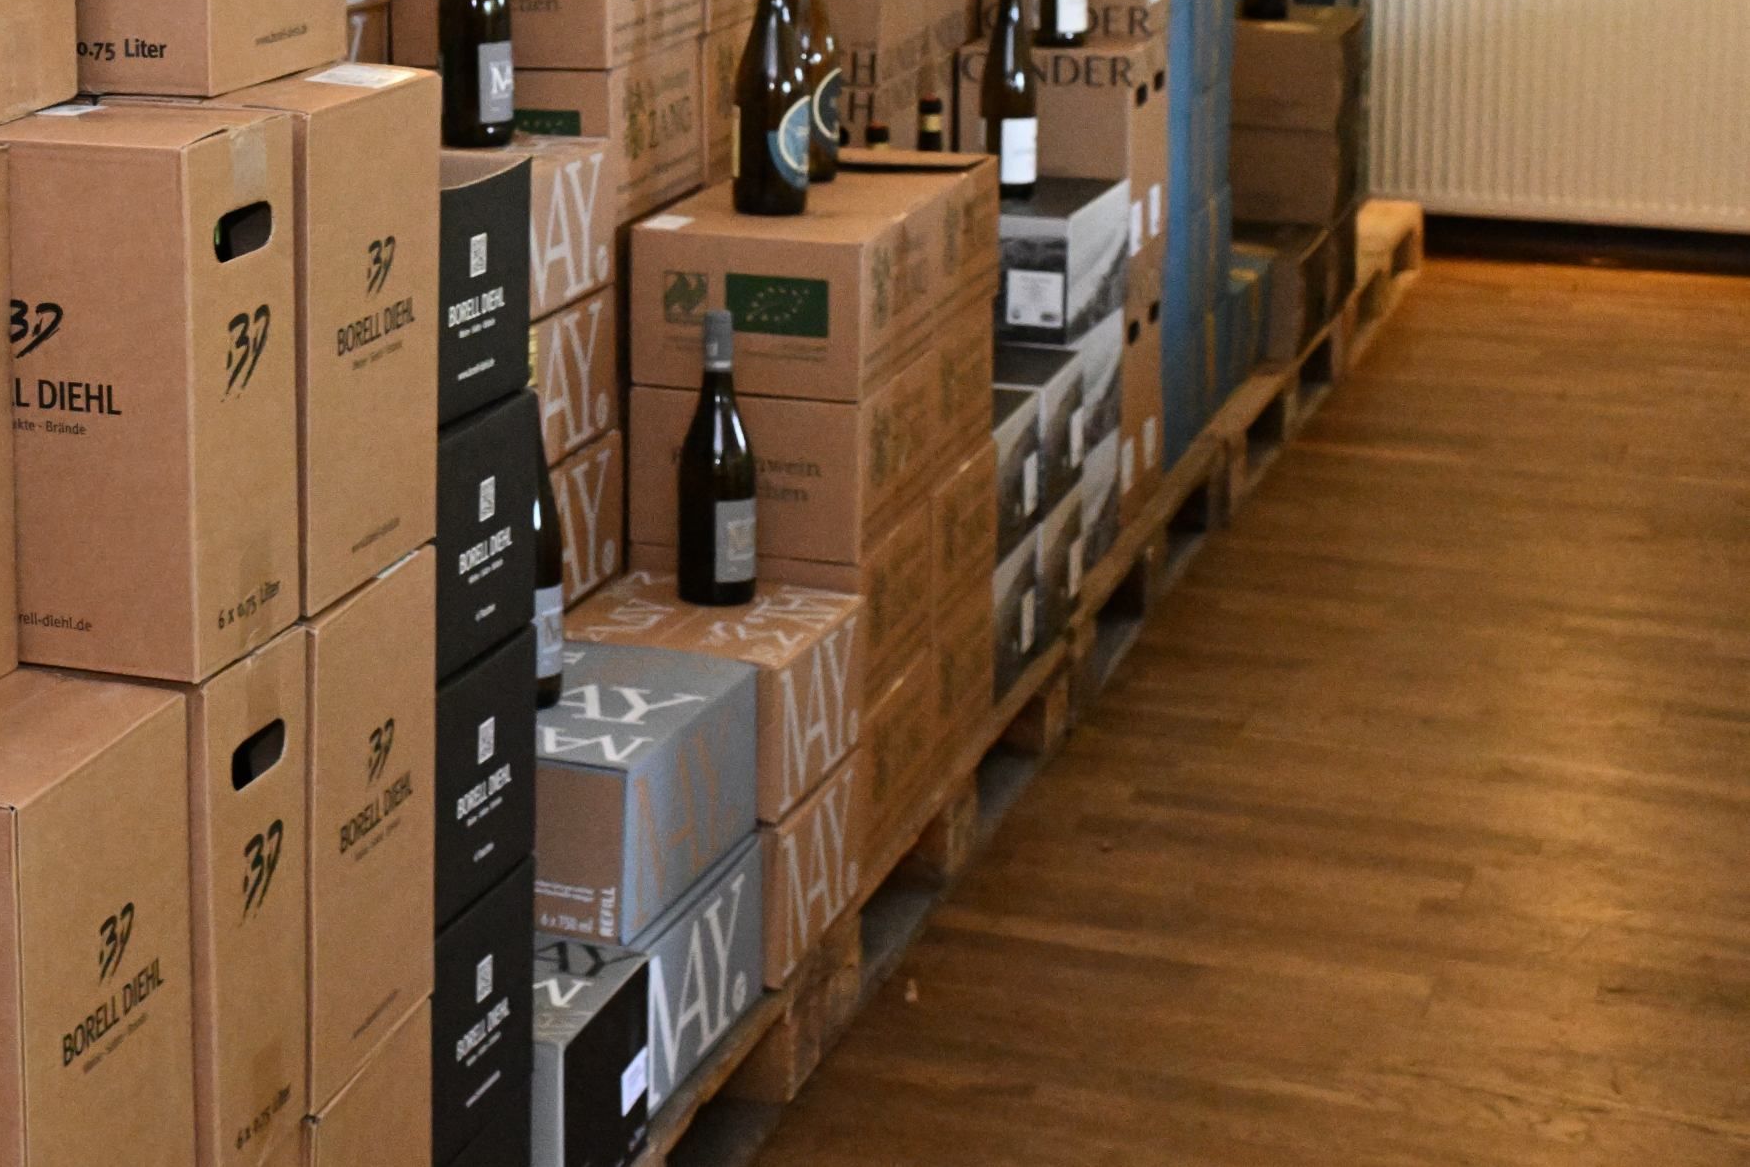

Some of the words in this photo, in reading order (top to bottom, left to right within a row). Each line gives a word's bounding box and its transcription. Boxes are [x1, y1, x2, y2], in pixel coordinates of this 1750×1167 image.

[124, 38, 168, 60] Liter
[337, 310, 382, 357] BORELL
[383, 297, 416, 336] DIEHL
[38, 379, 122, 416] DIEHL
[45, 420, 88, 436] Brände
[217, 610, 227, 631] 6
[339, 796, 382, 855] BORELL
[62, 995, 121, 1068] BORELL
[121, 957, 165, 1017] DIEHL
